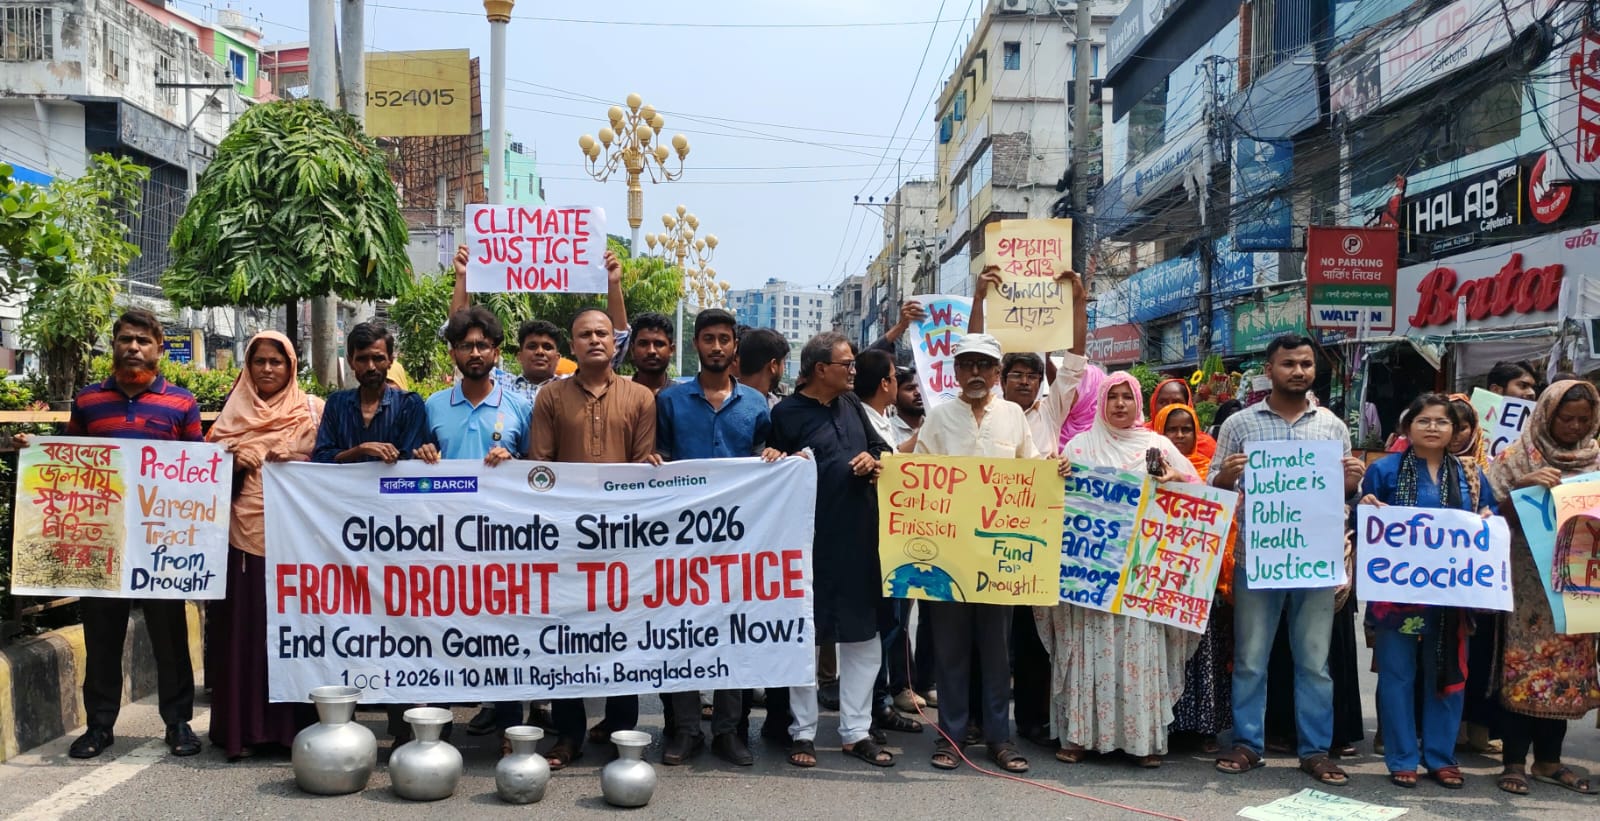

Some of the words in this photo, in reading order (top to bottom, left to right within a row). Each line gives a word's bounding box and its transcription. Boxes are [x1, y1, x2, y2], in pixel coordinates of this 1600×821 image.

[1415, 179, 1498, 235] HALAB
[474, 207, 591, 236] CLIMATE
[1480, 213, 1513, 232] Cafeteria
[478, 236, 589, 265] JUSTICE
[1565, 229, 1599, 250] বাটা
[1320, 258, 1335, 266] NO
[1338, 259, 1384, 267] PARKING
[1323, 268, 1350, 280] পার্কিং
[1352, 268, 1382, 280] নিষেধ
[507, 266, 568, 291] NOW!
[1408, 253, 1564, 328] Bata
[929, 303, 962, 327] We
[1320, 310, 1382, 322] WALTN
[925, 330, 960, 357] Wa
[140, 445, 223, 483] Protect
[1250, 448, 1316, 469] Climate
[383, 478, 415, 490] বারসিক
[433, 479, 476, 490] BARCIK
[604, 481, 645, 492] Green
[647, 474, 707, 489] Coalition
[900, 462, 968, 494] STOP
[979, 464, 1035, 485] Varend
[1248, 471, 1308, 495] Justice
[1312, 470, 1326, 490] is
[137, 484, 217, 522] Varend
[889, 491, 952, 514] Carbon
[993, 486, 1036, 507] Youth
[1252, 500, 1302, 524] Public
[141, 521, 201, 546] Tract
[342, 514, 444, 552] Global
[455, 514, 559, 552] Climate
[575, 513, 669, 550] Strike
[675, 505, 745, 545] 2026
[889, 512, 956, 538] Emission
[1063, 514, 1120, 539] oss
[1366, 513, 1490, 551] Defund
[1061, 532, 1106, 560] and
[1251, 527, 1308, 549] Health
[151, 545, 205, 572] from
[992, 540, 1033, 563] Fund
[999, 560, 1021, 573] For
[1060, 564, 1120, 592] amage
[1248, 553, 1336, 582] Justice!
[131, 567, 216, 593] Drought
[276, 562, 372, 615] FROM
[383, 561, 559, 617] DROUGHT
[577, 561, 629, 613] TO
[643, 549, 805, 609] JUSTICE
[1060, 586, 1106, 606] und
[279, 626, 325, 659] End
[332, 625, 433, 659] Carbon
[442, 627, 531, 659] Game,
[539, 623, 628, 655] Climate
[637, 618, 719, 651] Justice
[730, 613, 805, 645] Now!
[340, 669, 349, 686] 1
[396, 670, 441, 687] 2026
[458, 668, 480, 687] 10
[484, 668, 509, 686] AM
[529, 665, 610, 690] Rajshahi,
[613, 657, 729, 689] Bangladesh
